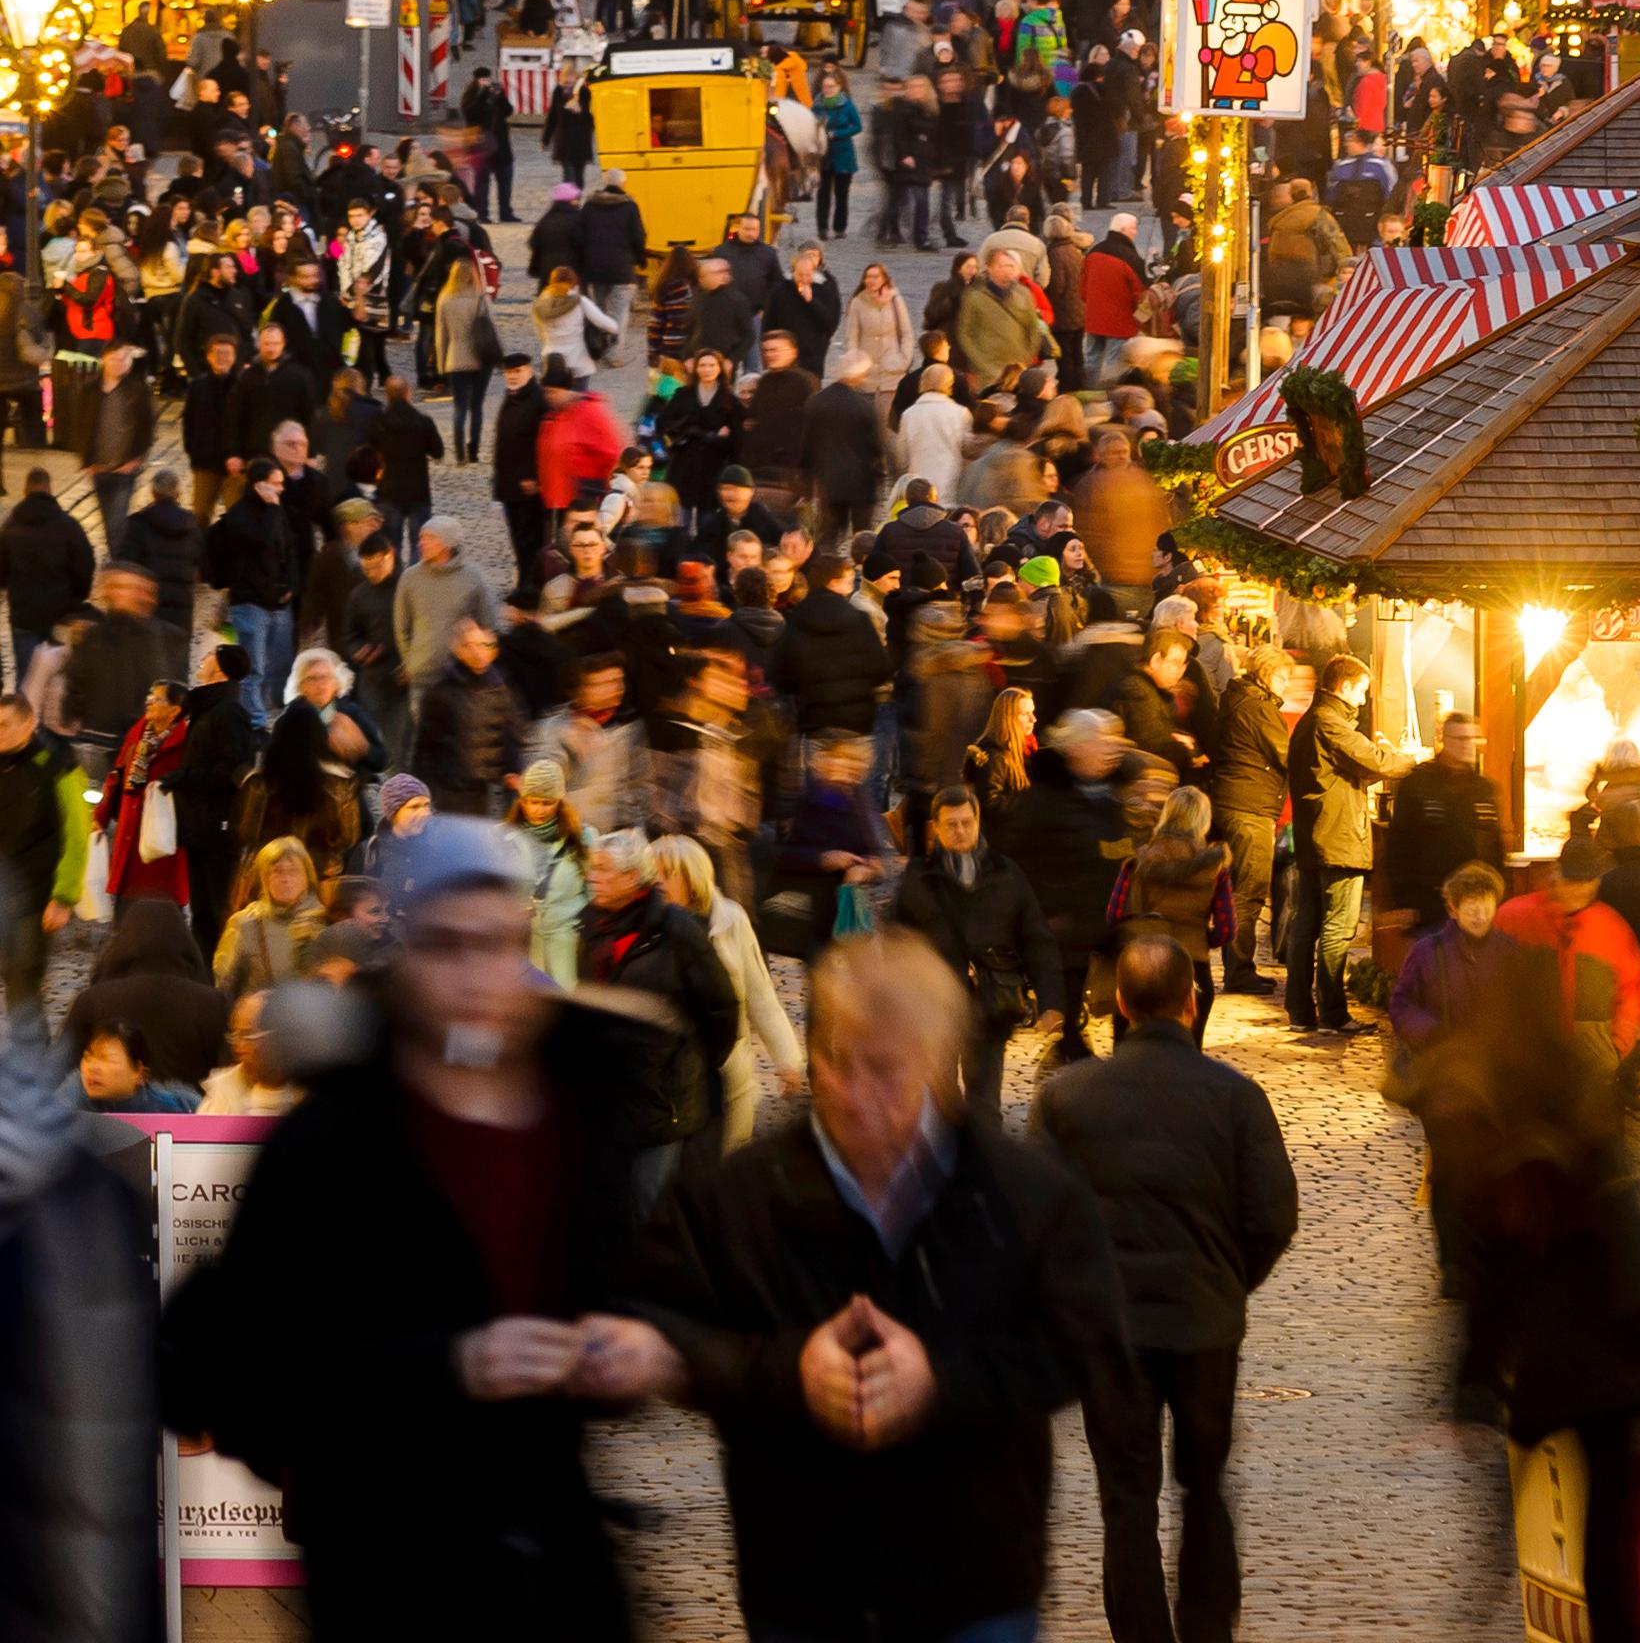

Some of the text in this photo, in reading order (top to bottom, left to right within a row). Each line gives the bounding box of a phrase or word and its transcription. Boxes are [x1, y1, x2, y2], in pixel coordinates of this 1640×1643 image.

[1228, 431, 1304, 475] GERST
[172, 1184, 248, 1202] CARO
[175, 1237, 209, 1246] LICH
